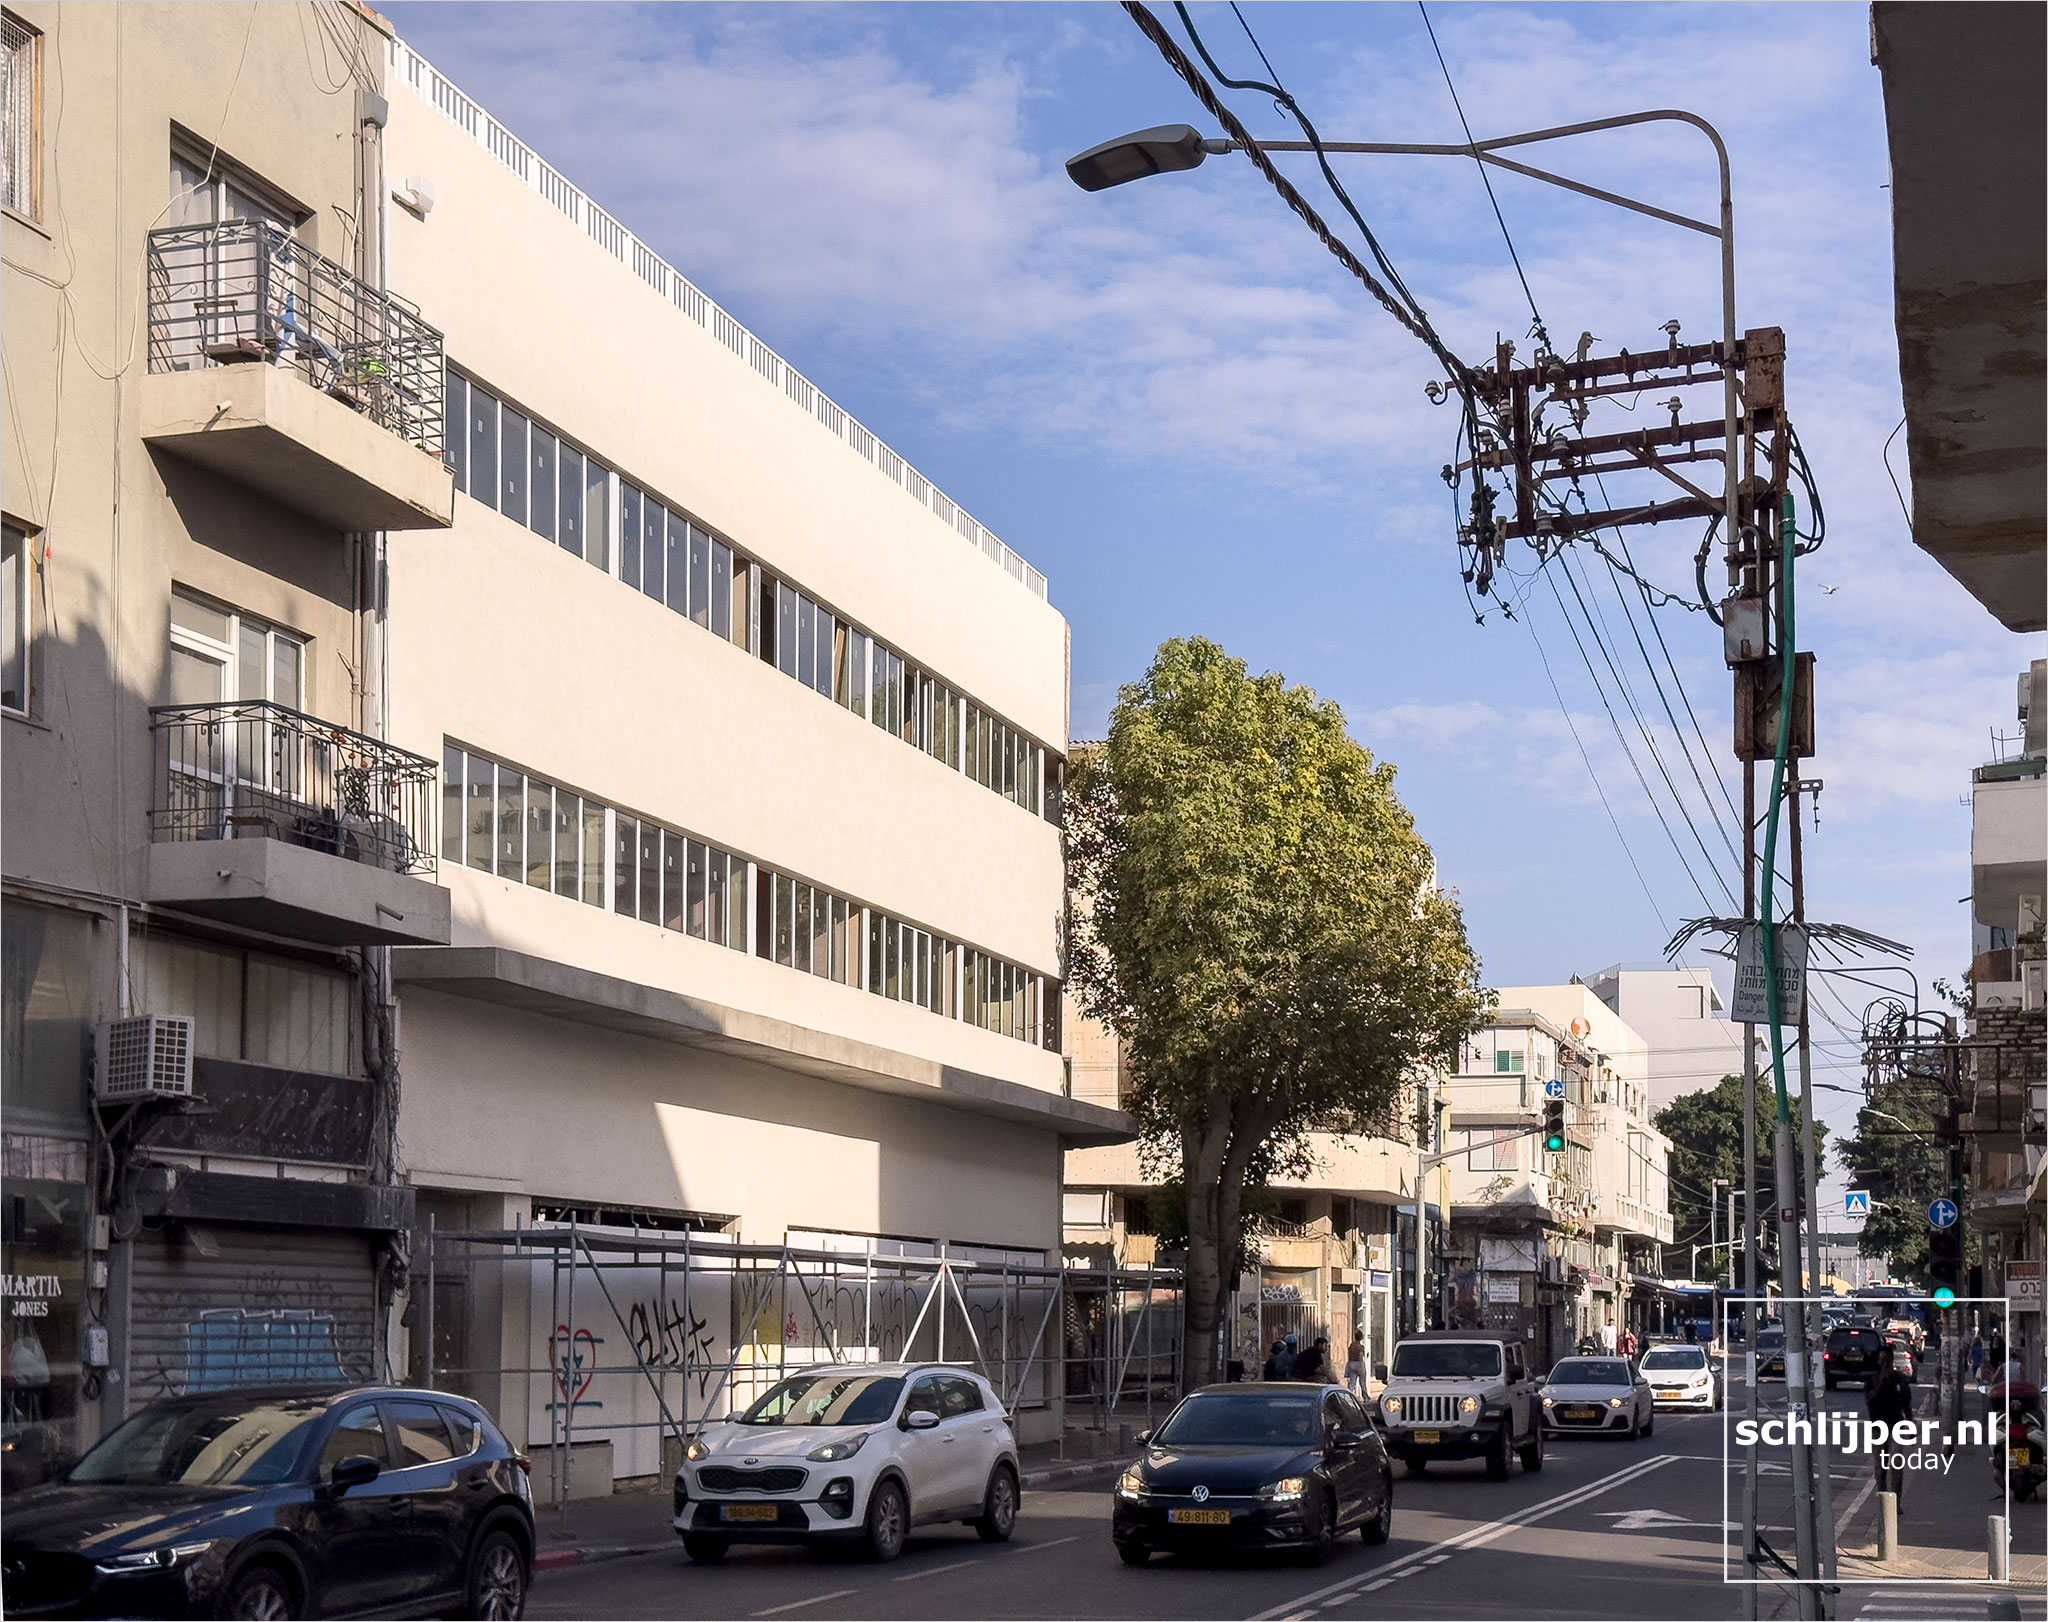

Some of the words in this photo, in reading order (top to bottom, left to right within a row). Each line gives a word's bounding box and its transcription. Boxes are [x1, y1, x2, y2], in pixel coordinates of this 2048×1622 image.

[1741, 965, 1767, 977] בוה!
[1739, 990, 1765, 1003] Danger
[12, 1301, 49, 1317] JONES
